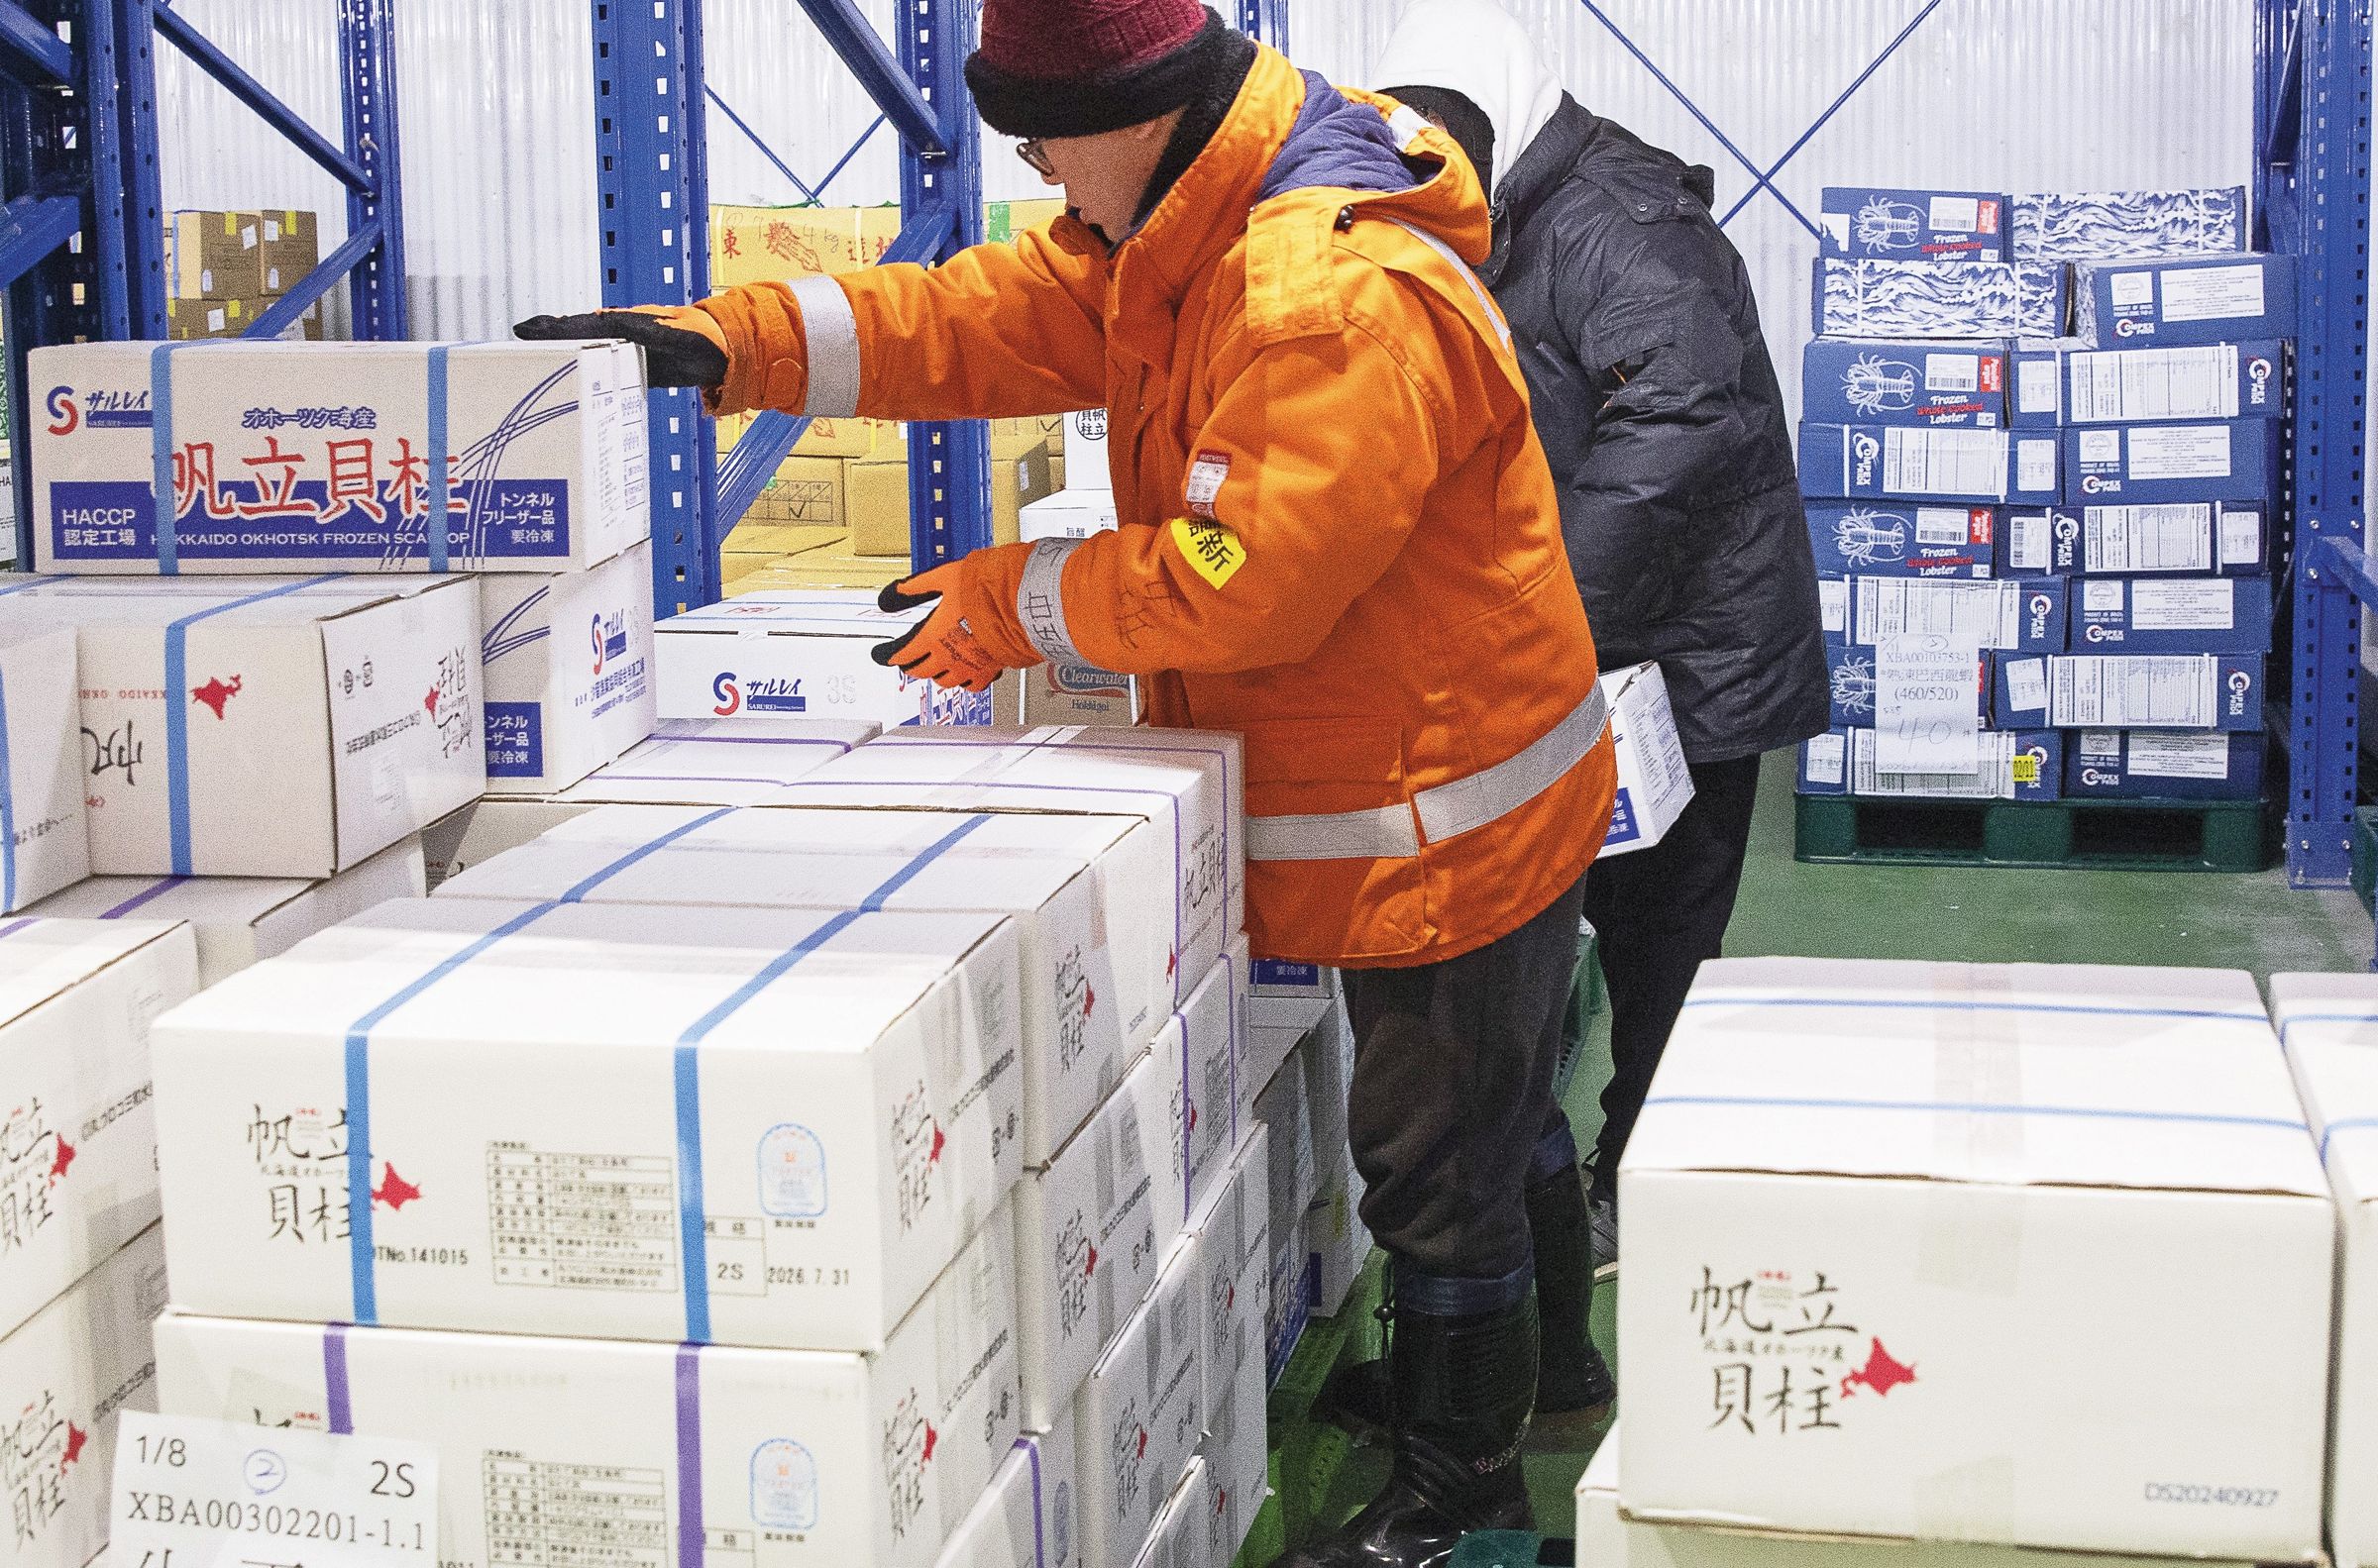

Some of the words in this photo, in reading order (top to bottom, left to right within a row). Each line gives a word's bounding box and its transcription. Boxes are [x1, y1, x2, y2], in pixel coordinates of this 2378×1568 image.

[241, 406, 377, 430] オホーツク海産
[501, 494, 555, 507] トンネル
[62, 508, 136, 526] HACCP
[483, 510, 555, 525] フリーザー品
[63, 528, 136, 547] 認定工場
[152, 533, 237, 545] HKKAIDO
[240, 533, 315, 545] OKHOTSK
[323, 533, 390, 545] FROZEN
[393, 532, 470, 545] SCAOP
[512, 529, 555, 544] 要冷凍
[746, 679, 802, 697] サルレイ
[1893, 685, 1959, 700] (460/520)
[372, 1246, 468, 1265] TNo.141015
[717, 1262, 744, 1281] 2S
[1690, 1266, 1858, 1336] 帆立
[1708, 1362, 1841, 1433] 貝柱
[137, 1435, 187, 1468] 1/8
[371, 1460, 416, 1499] 2S
[128, 1491, 425, 1551] XBA00302201-1.1
